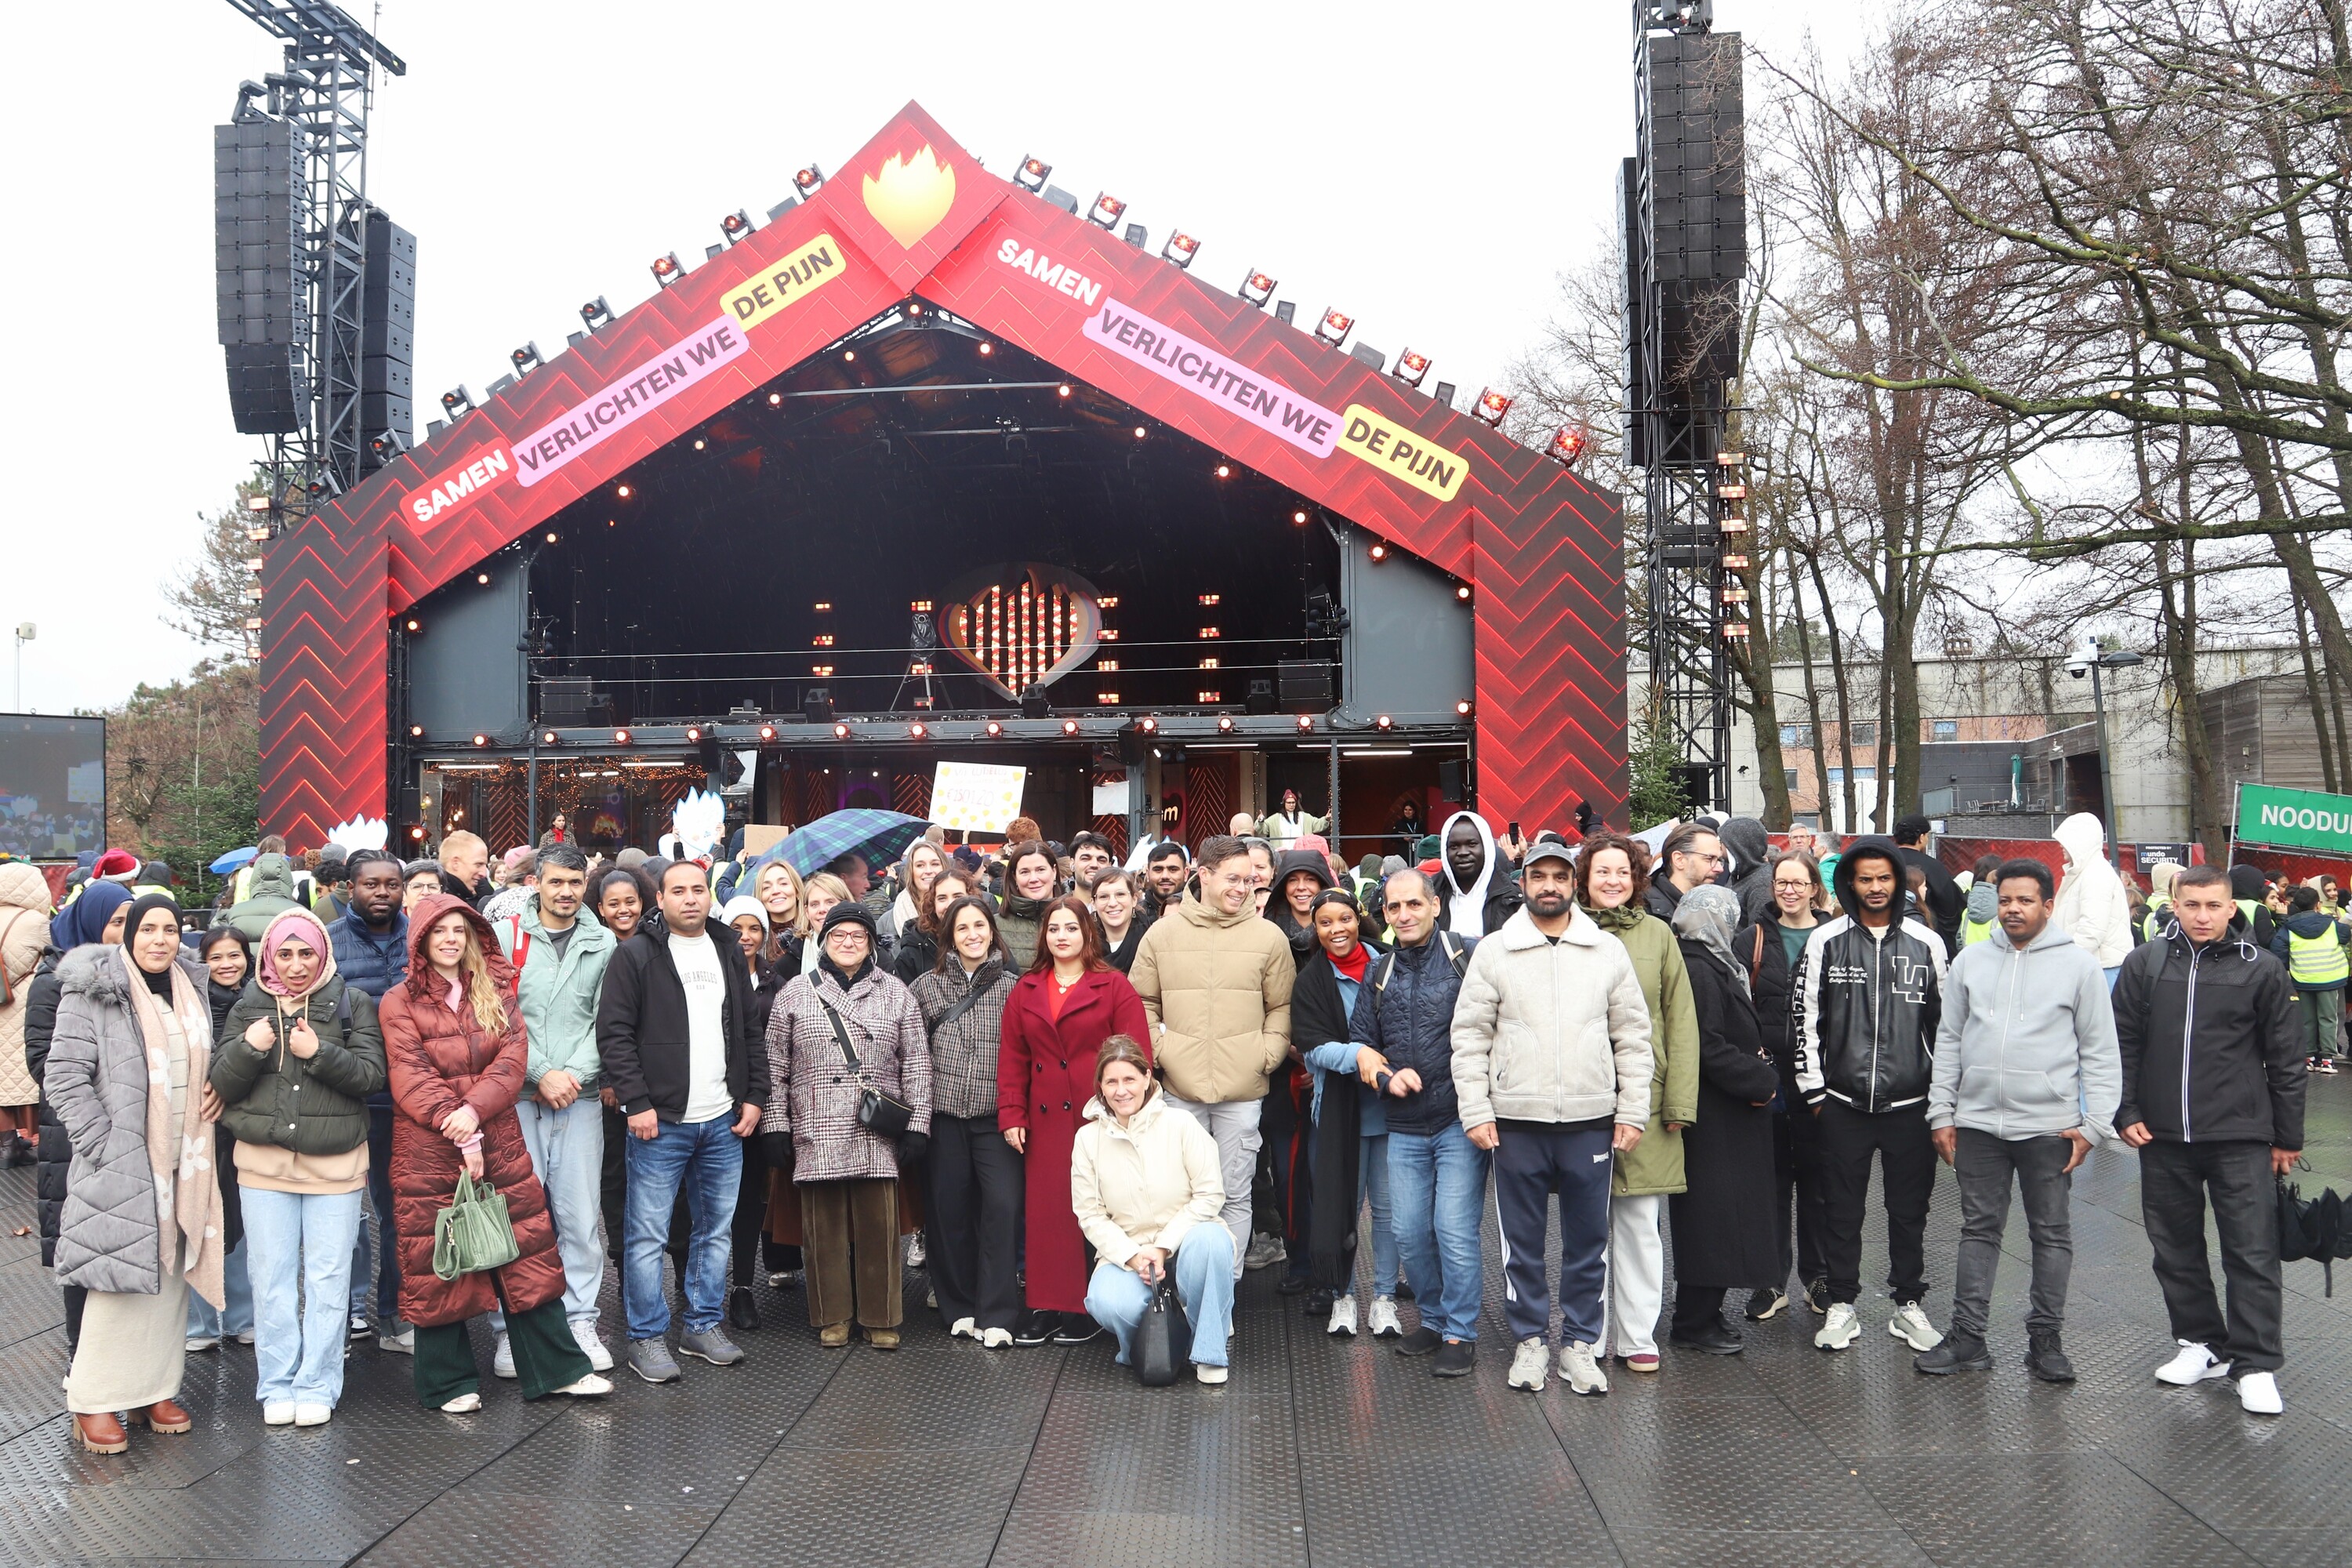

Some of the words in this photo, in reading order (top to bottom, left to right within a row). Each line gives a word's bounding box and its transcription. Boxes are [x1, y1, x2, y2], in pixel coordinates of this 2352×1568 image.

[732, 284, 769, 321] DE
[773, 246, 834, 296] PIJN
[997, 238, 1102, 307] SAMEN
[518, 356, 689, 471] VERLICHTEN
[690, 326, 738, 367] WE
[1100, 308, 1279, 417] VERLICHTEN
[1282, 402, 1333, 446] WE
[412, 450, 510, 523] SAMEN
[1345, 417, 1392, 456] DE
[1390, 438, 1457, 489] PIJN
[681, 972, 691, 985] LOS
[692, 971, 717, 984] ANGELES
[1892, 956, 1929, 1004] LA
